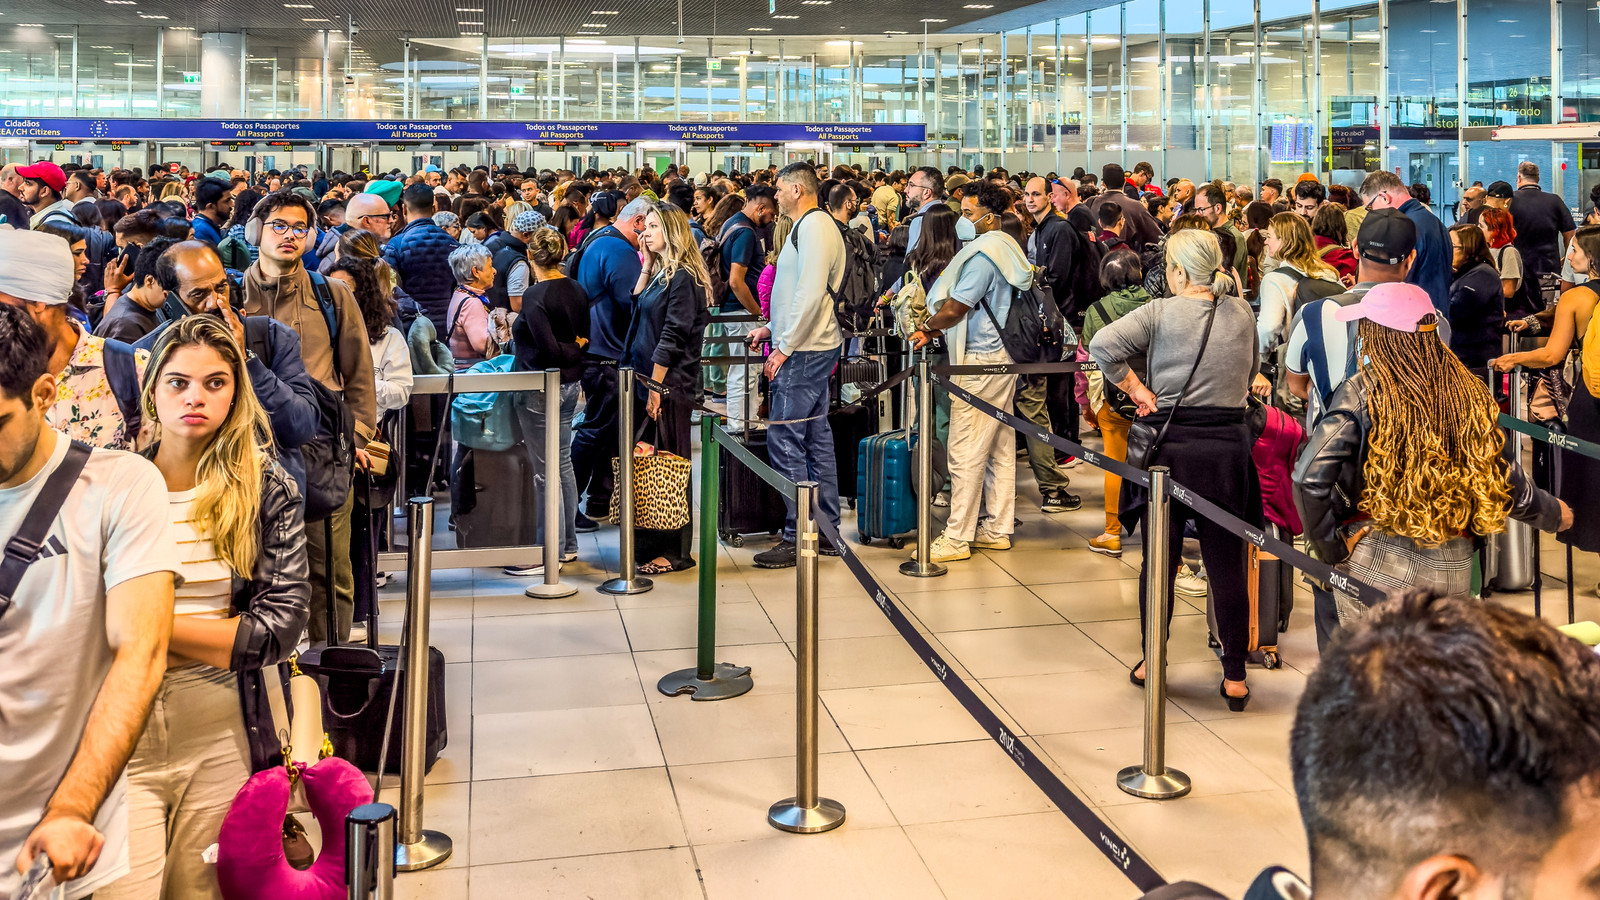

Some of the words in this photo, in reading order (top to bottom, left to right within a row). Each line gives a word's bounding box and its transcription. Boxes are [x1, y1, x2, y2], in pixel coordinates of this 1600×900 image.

[1508, 88, 1518, 98] 26
[0, 128, 28, 136] EA/CH
[646, 381, 662, 391] VINCI
[1100, 832, 1121, 857] VINCI
